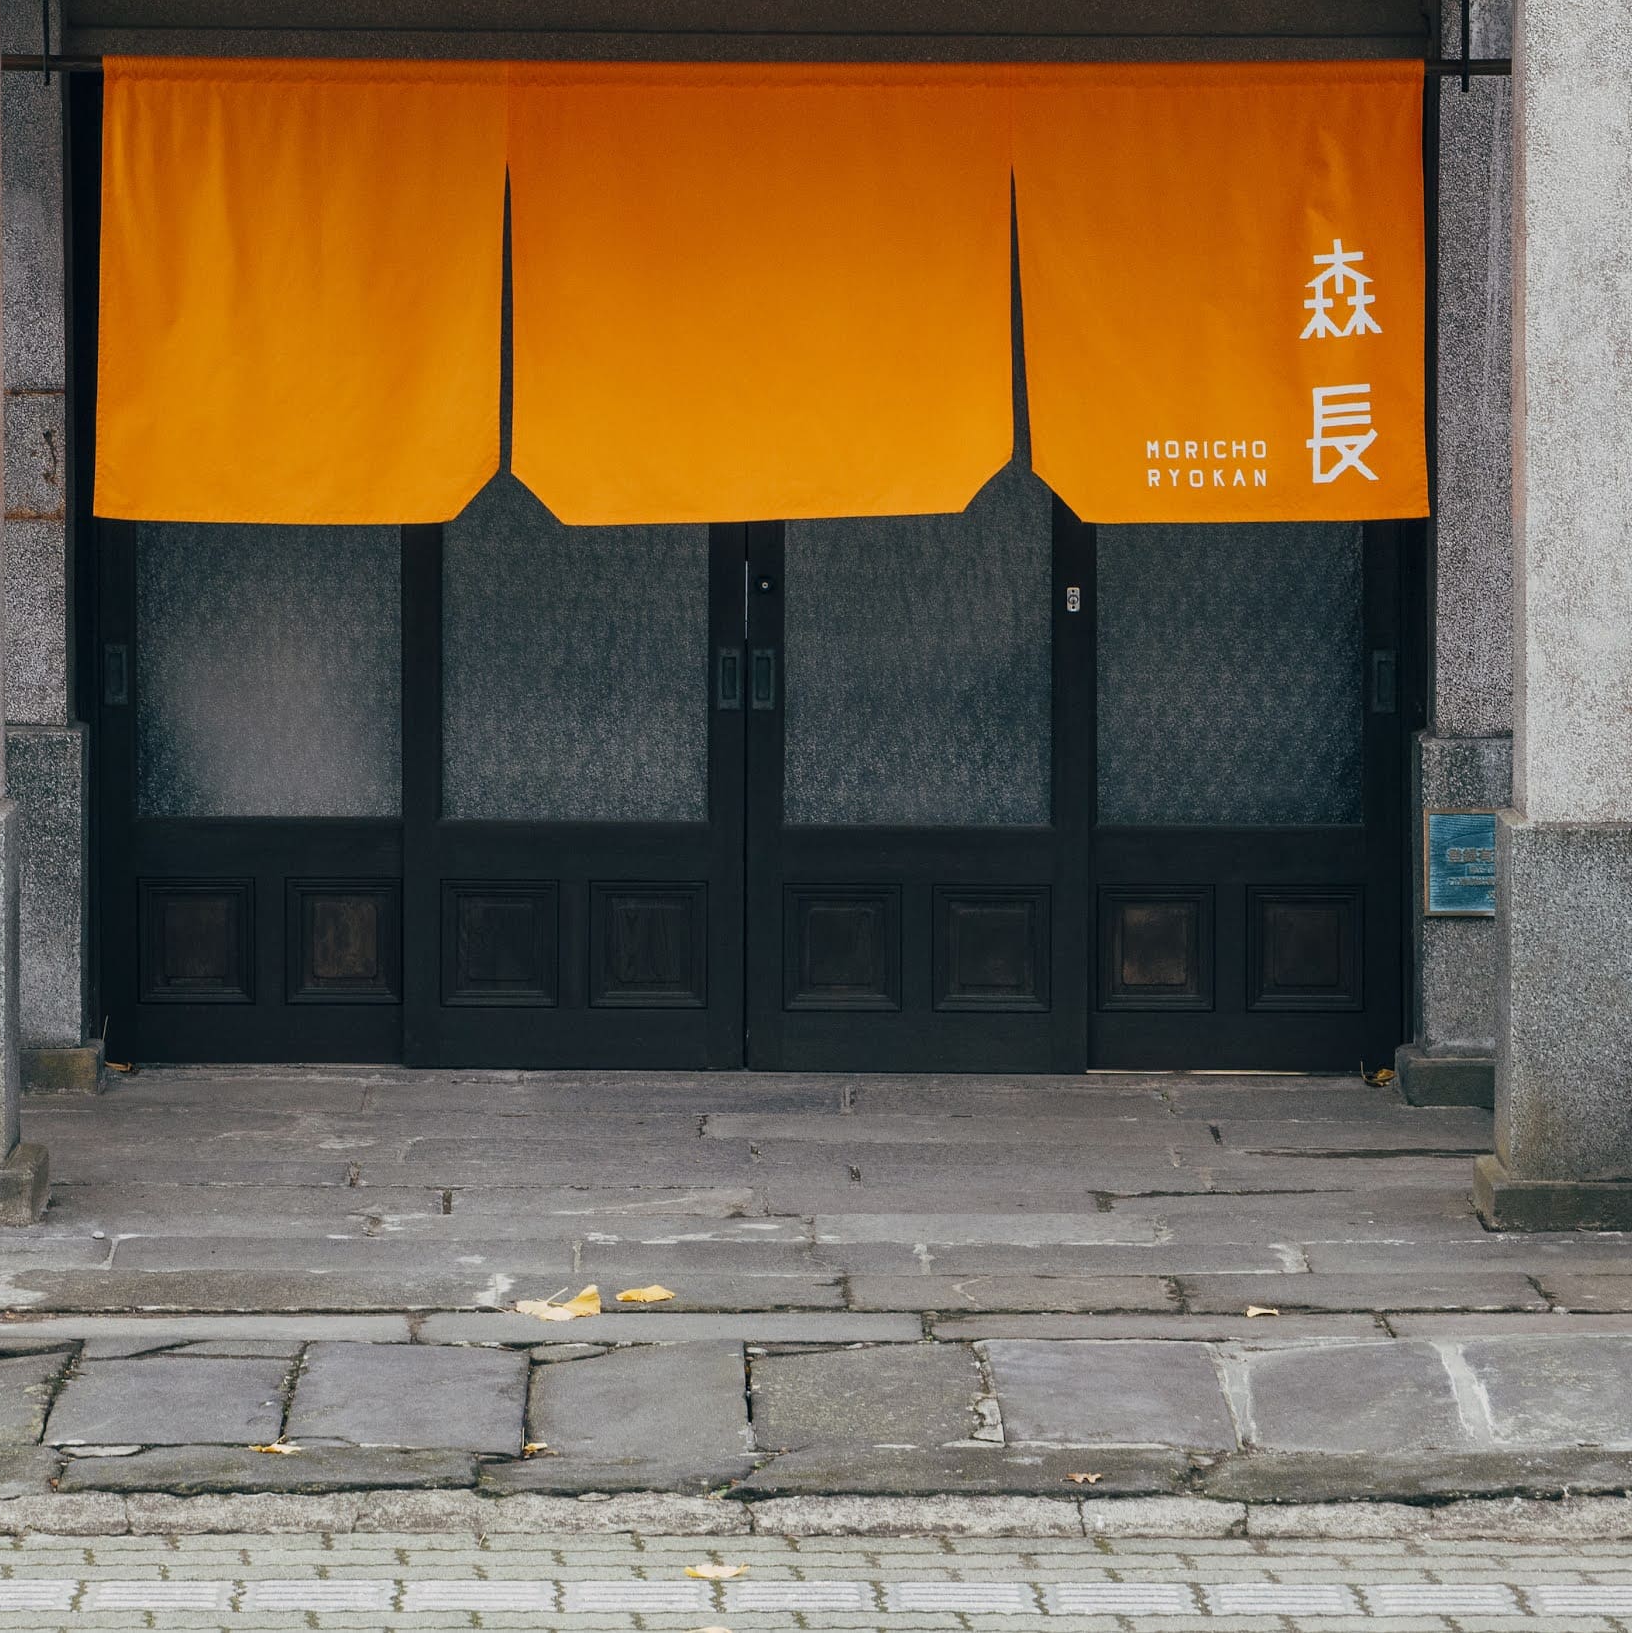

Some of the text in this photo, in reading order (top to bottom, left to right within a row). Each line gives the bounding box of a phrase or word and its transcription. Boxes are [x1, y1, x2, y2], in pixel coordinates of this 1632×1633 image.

[1299, 238, 1383, 484] 森長
[1146, 440, 1267, 459] MORICHO
[1148, 469, 1267, 488] RYOKAN
